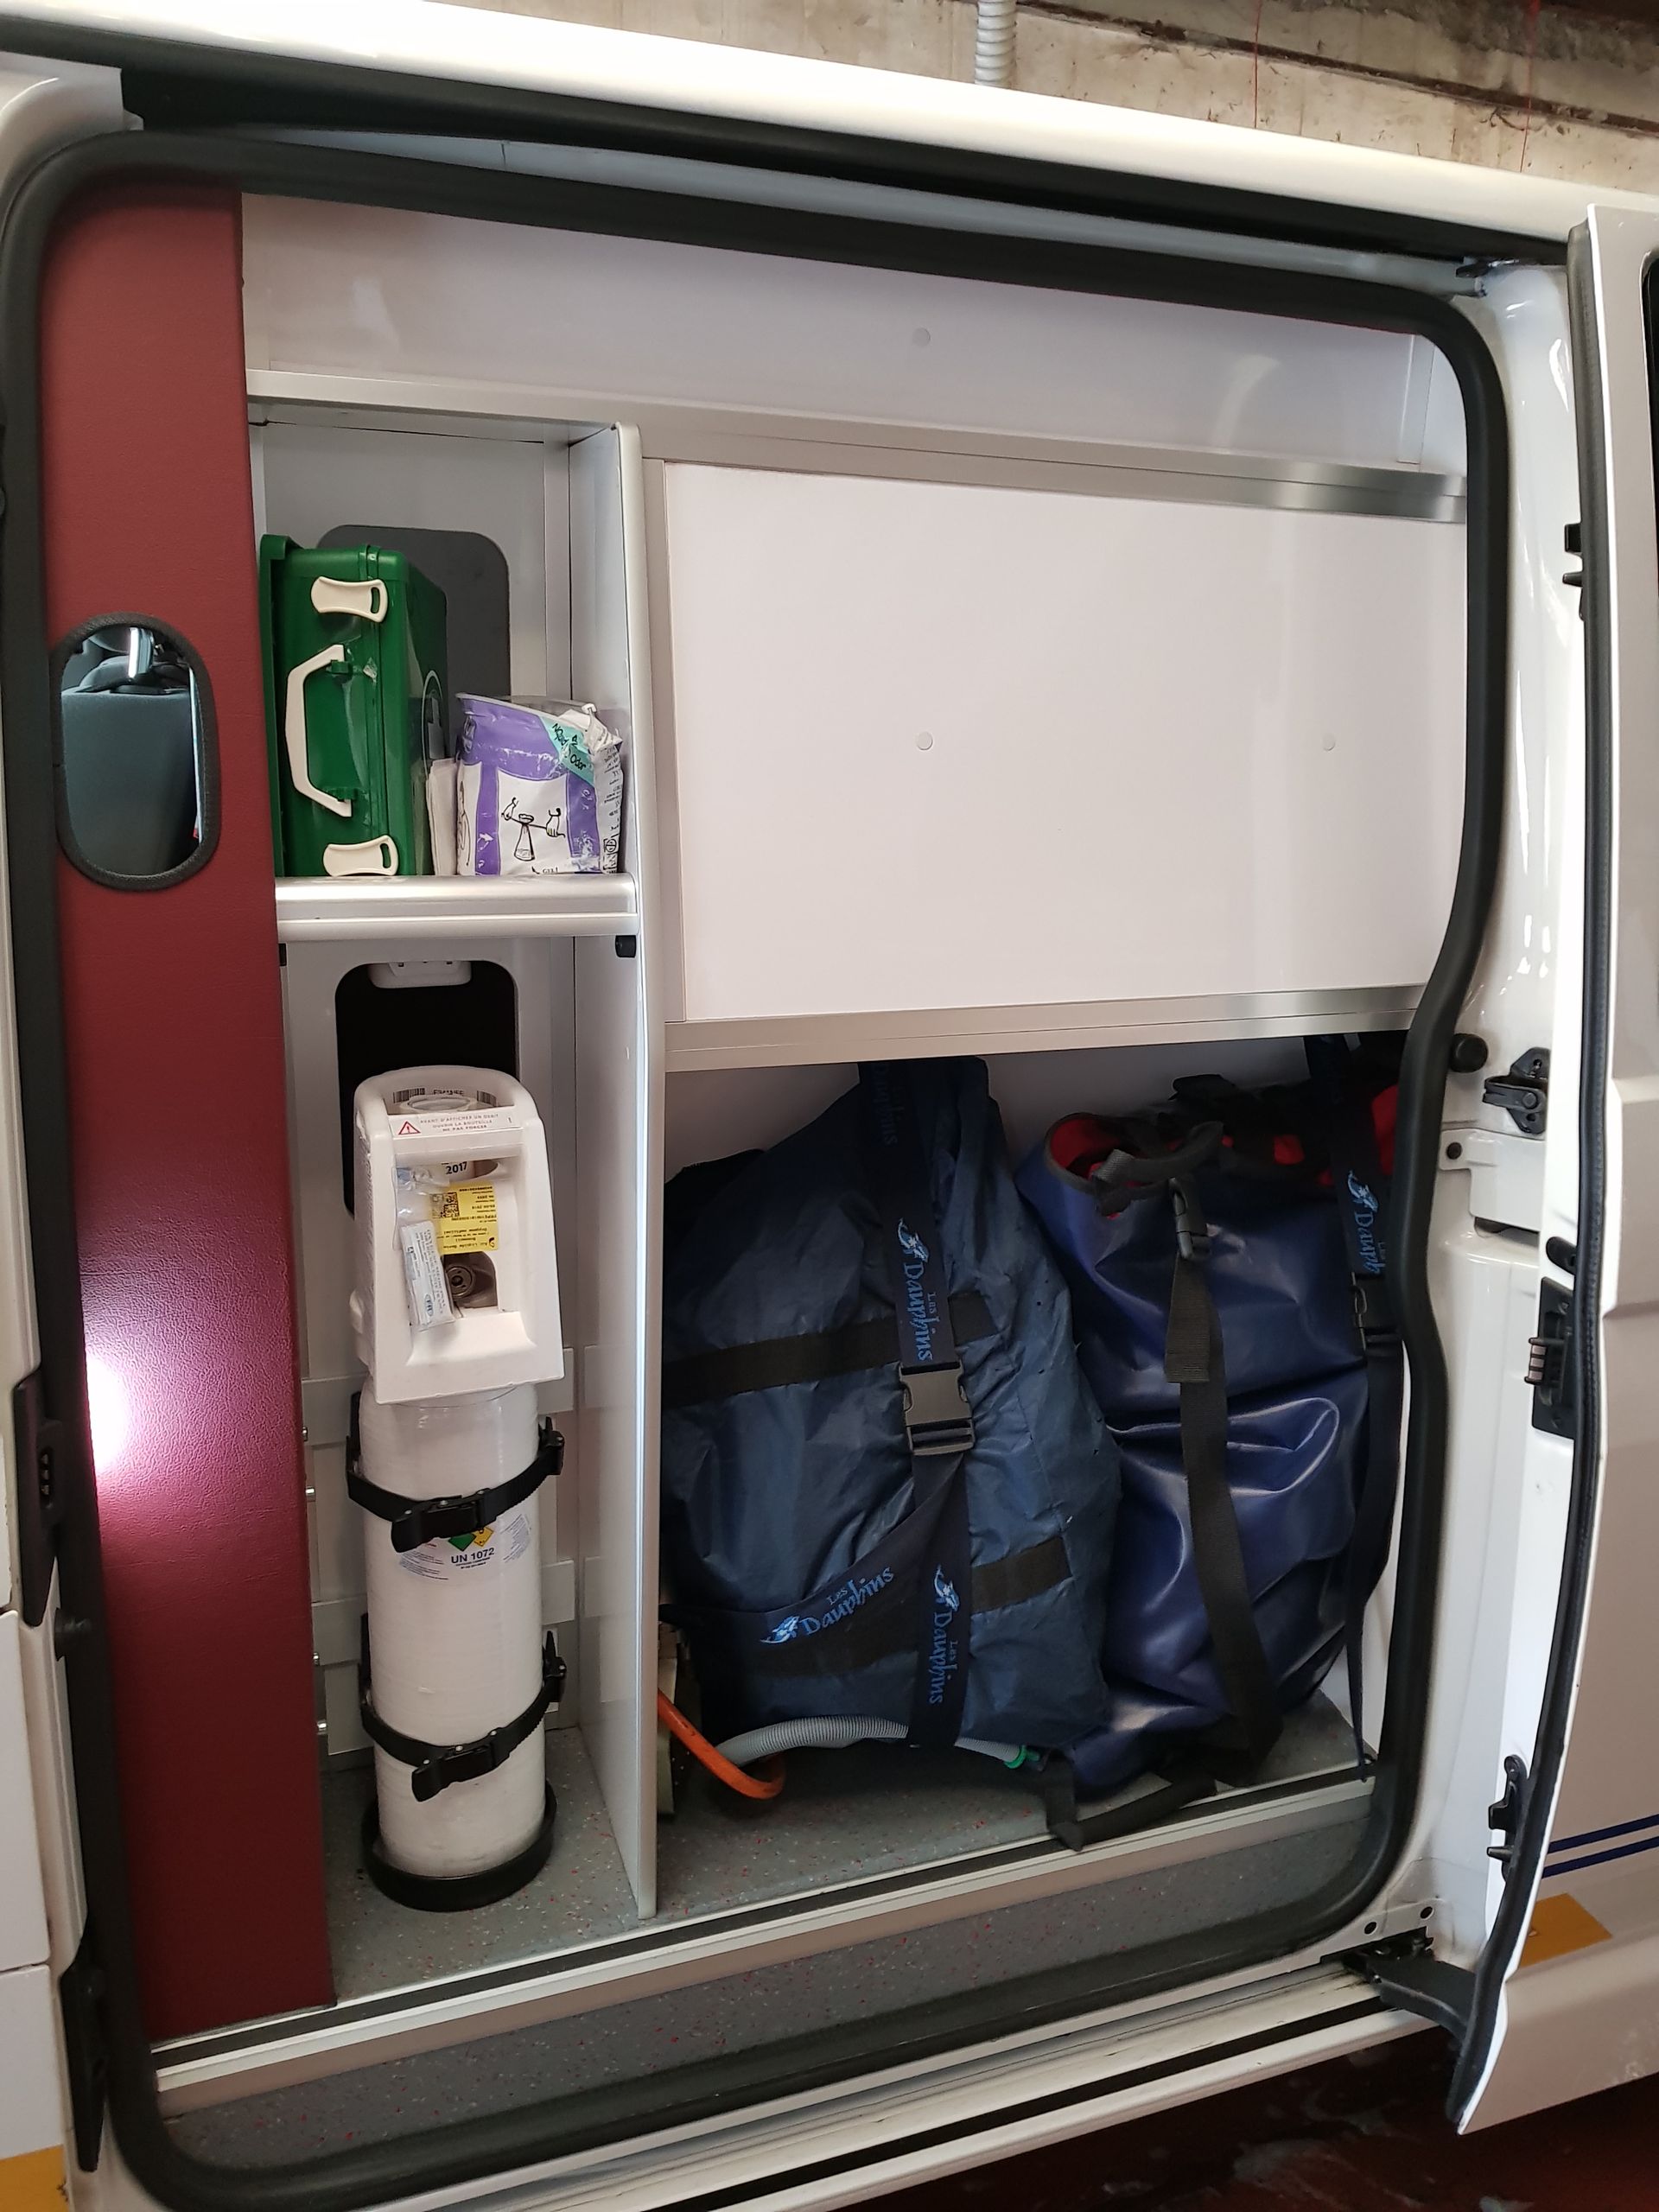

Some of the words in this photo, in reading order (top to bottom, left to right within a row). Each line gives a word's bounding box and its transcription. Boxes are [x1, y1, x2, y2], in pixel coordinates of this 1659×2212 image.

[446, 1161, 467, 1174] 2017
[904, 1262, 940, 1361] Dauphins
[927, 1292, 938, 1314] Les
[451, 1554, 467, 1564] UN
[471, 1548, 495, 1560] 1072
[798, 1567, 894, 1636] Dauphins
[826, 1587, 848, 1605] Les
[928, 1610, 958, 1704] Dauphins
